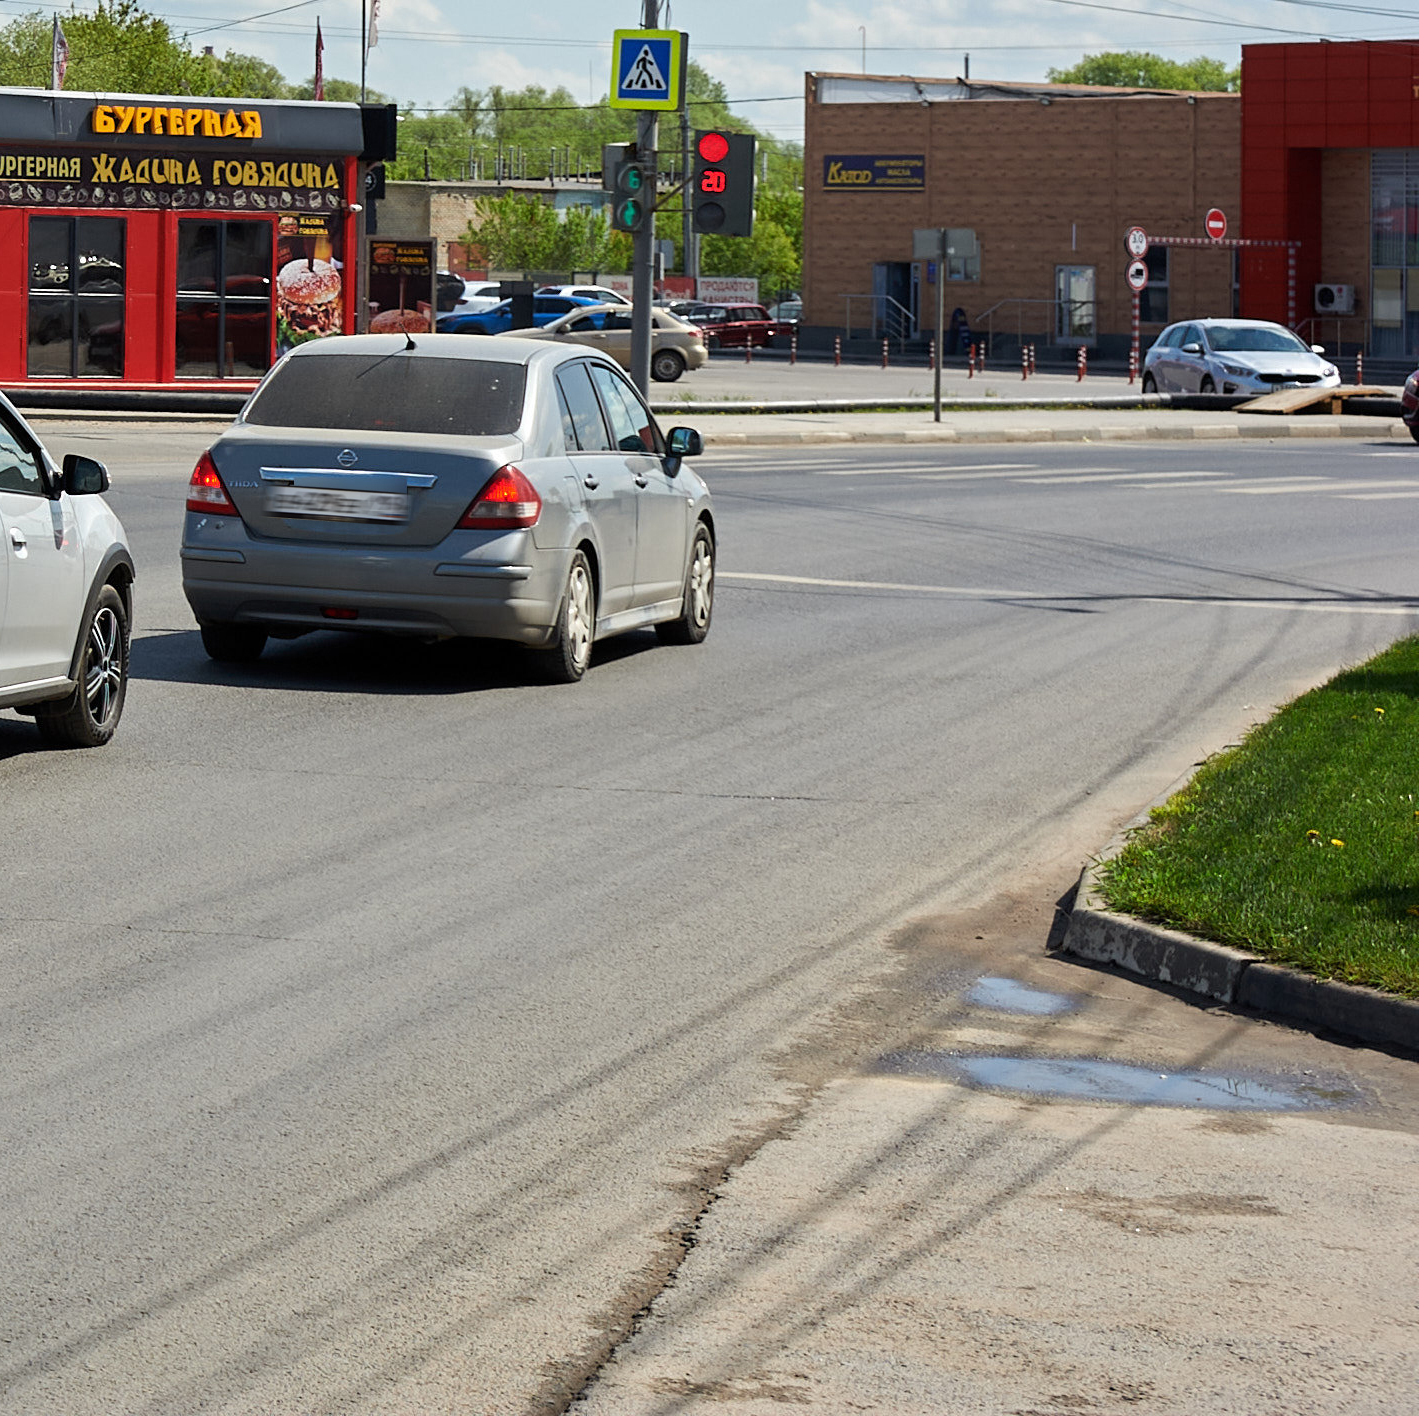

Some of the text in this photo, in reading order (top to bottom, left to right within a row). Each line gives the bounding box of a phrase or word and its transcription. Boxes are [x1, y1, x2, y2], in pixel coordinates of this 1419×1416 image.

[92, 104, 263, 139] БУРГЕРНАЯ
[91, 153, 202, 184] ЖАДИНА
[213, 160, 340, 189] ГОВЯДИНА
[701, 170, 726, 193] 20
[700, 281, 755, 291] ПРОДАЮТСЯ
